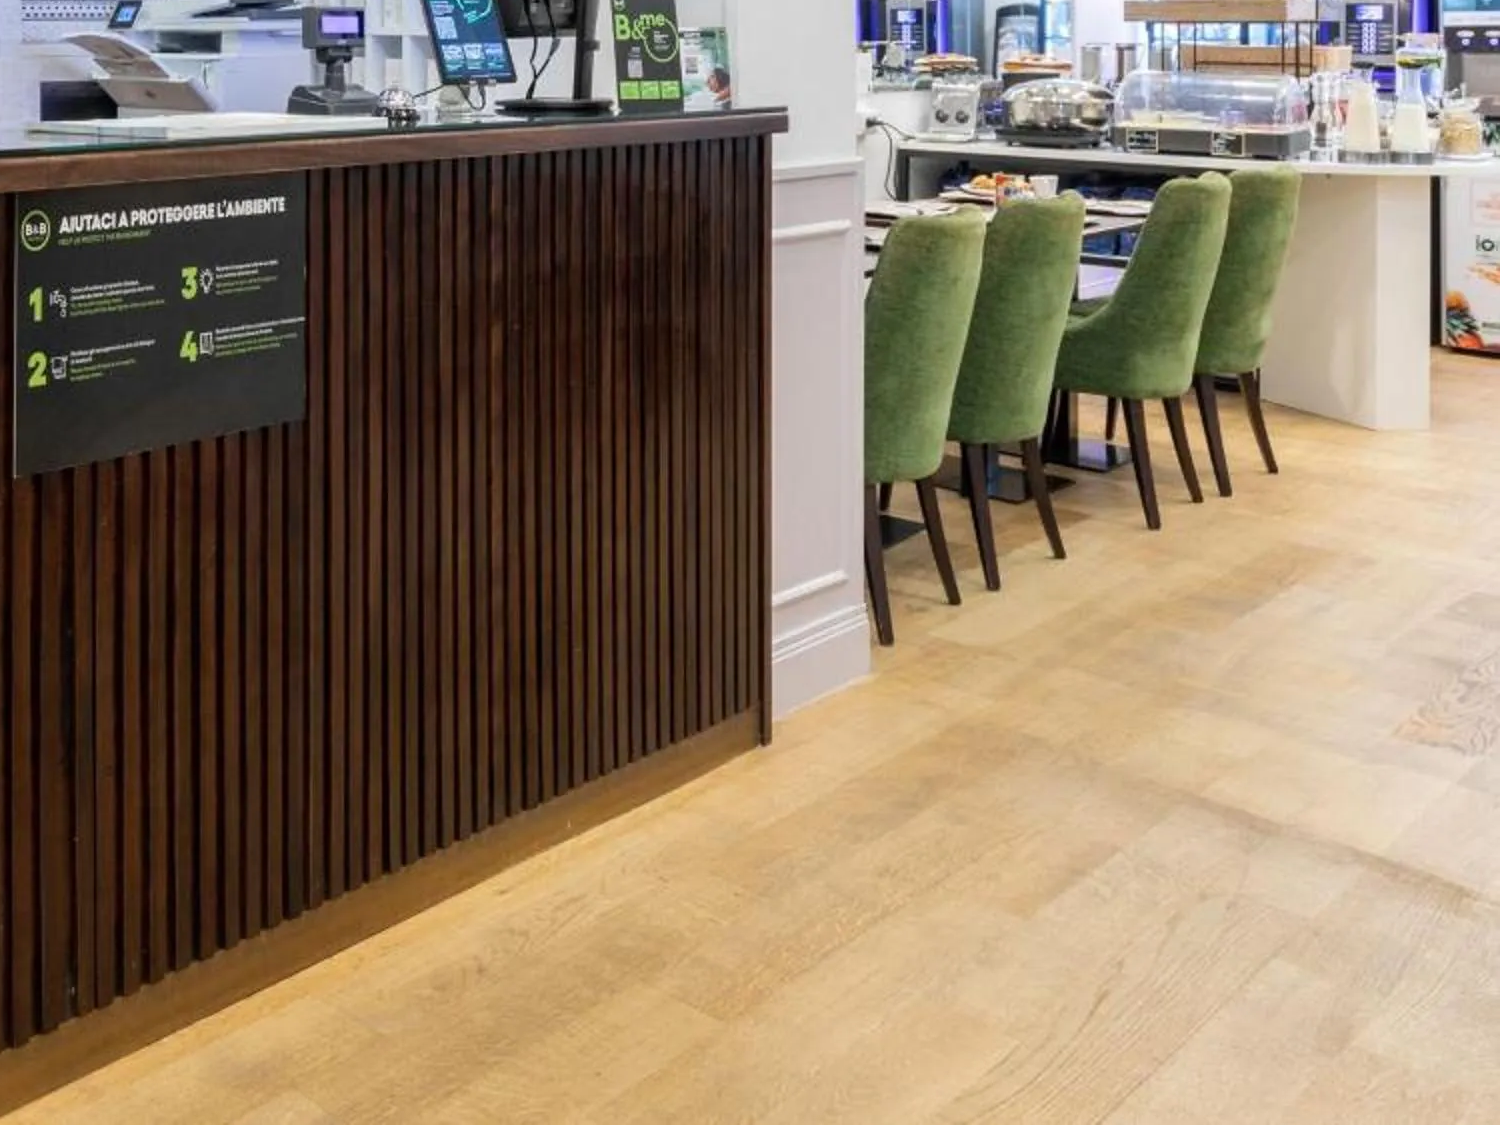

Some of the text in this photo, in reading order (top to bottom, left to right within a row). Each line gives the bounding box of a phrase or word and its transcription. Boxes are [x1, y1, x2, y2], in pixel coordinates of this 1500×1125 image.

[25, 222, 47, 236] B&B
[59, 196, 286, 234] AIUTACI A PROTEGGERE L'AMBIENTE
[181, 266, 198, 300] 3
[28, 286, 43, 322] 1
[180, 330, 198, 363] 4
[27, 351, 47, 388] 2
